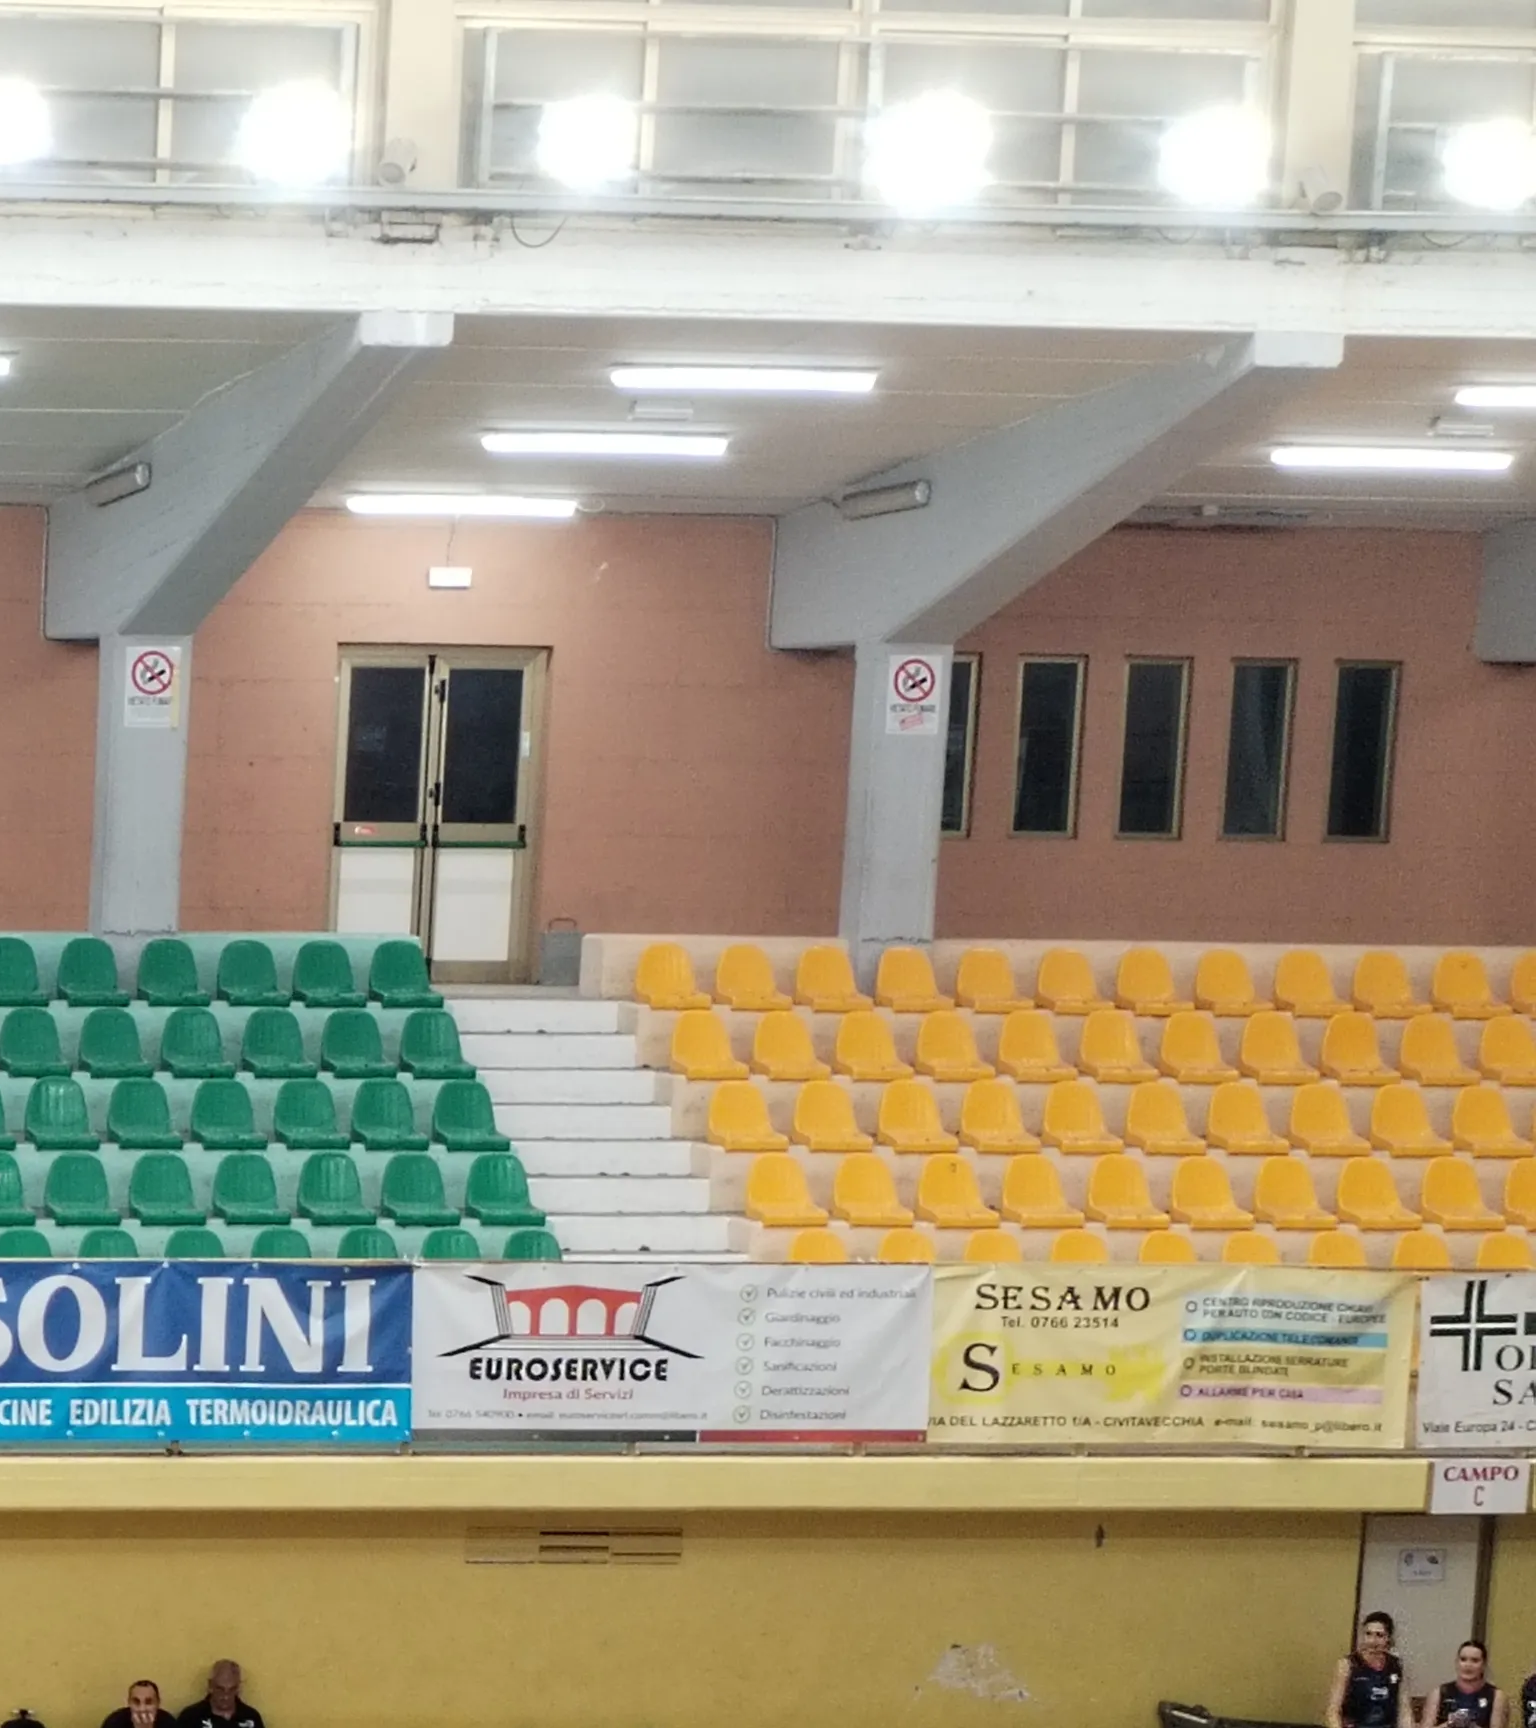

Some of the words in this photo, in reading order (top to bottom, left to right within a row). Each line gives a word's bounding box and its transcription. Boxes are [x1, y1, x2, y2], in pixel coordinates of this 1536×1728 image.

[766, 1287, 806, 1299] Pulizie
[839, 1287, 854, 1298] ed
[857, 1287, 917, 1299] industriali
[974, 1283, 1151, 1312] SESAMO
[765, 1312, 841, 1325] Giardinaggio
[1000, 1316, 1025, 1328] Tel.
[1030, 1316, 1069, 1328] 0766
[1074, 1317, 1120, 1328] 23514
[1285, 1312, 1327, 1323] CODICE
[764, 1336, 841, 1350] Facchinaggio
[468, 1357, 670, 1382] EUROSERVICE
[763, 1360, 838, 1372] Sanificazioni
[503, 1388, 562, 1402] Impresa
[566, 1388, 580, 1400] di
[584, 1388, 635, 1401] Servizi
[761, 1385, 850, 1396] Derattizzazioni
[69, 1399, 172, 1427] EDILIZIA
[186, 1398, 399, 1427] TERMOIDRAULICA
[759, 1408, 846, 1421] Disinfestazioni
[949, 1416, 977, 1427] DEL
[982, 1416, 1067, 1427] LAZZARETTO
[1103, 1416, 1204, 1427] CIVITAVECCHIA
[1422, 1422, 1450, 1434] Viale
[1454, 1422, 1497, 1434] Europa
[1442, 1465, 1520, 1483] CAMPO
[1473, 1485, 1485, 1507] C
